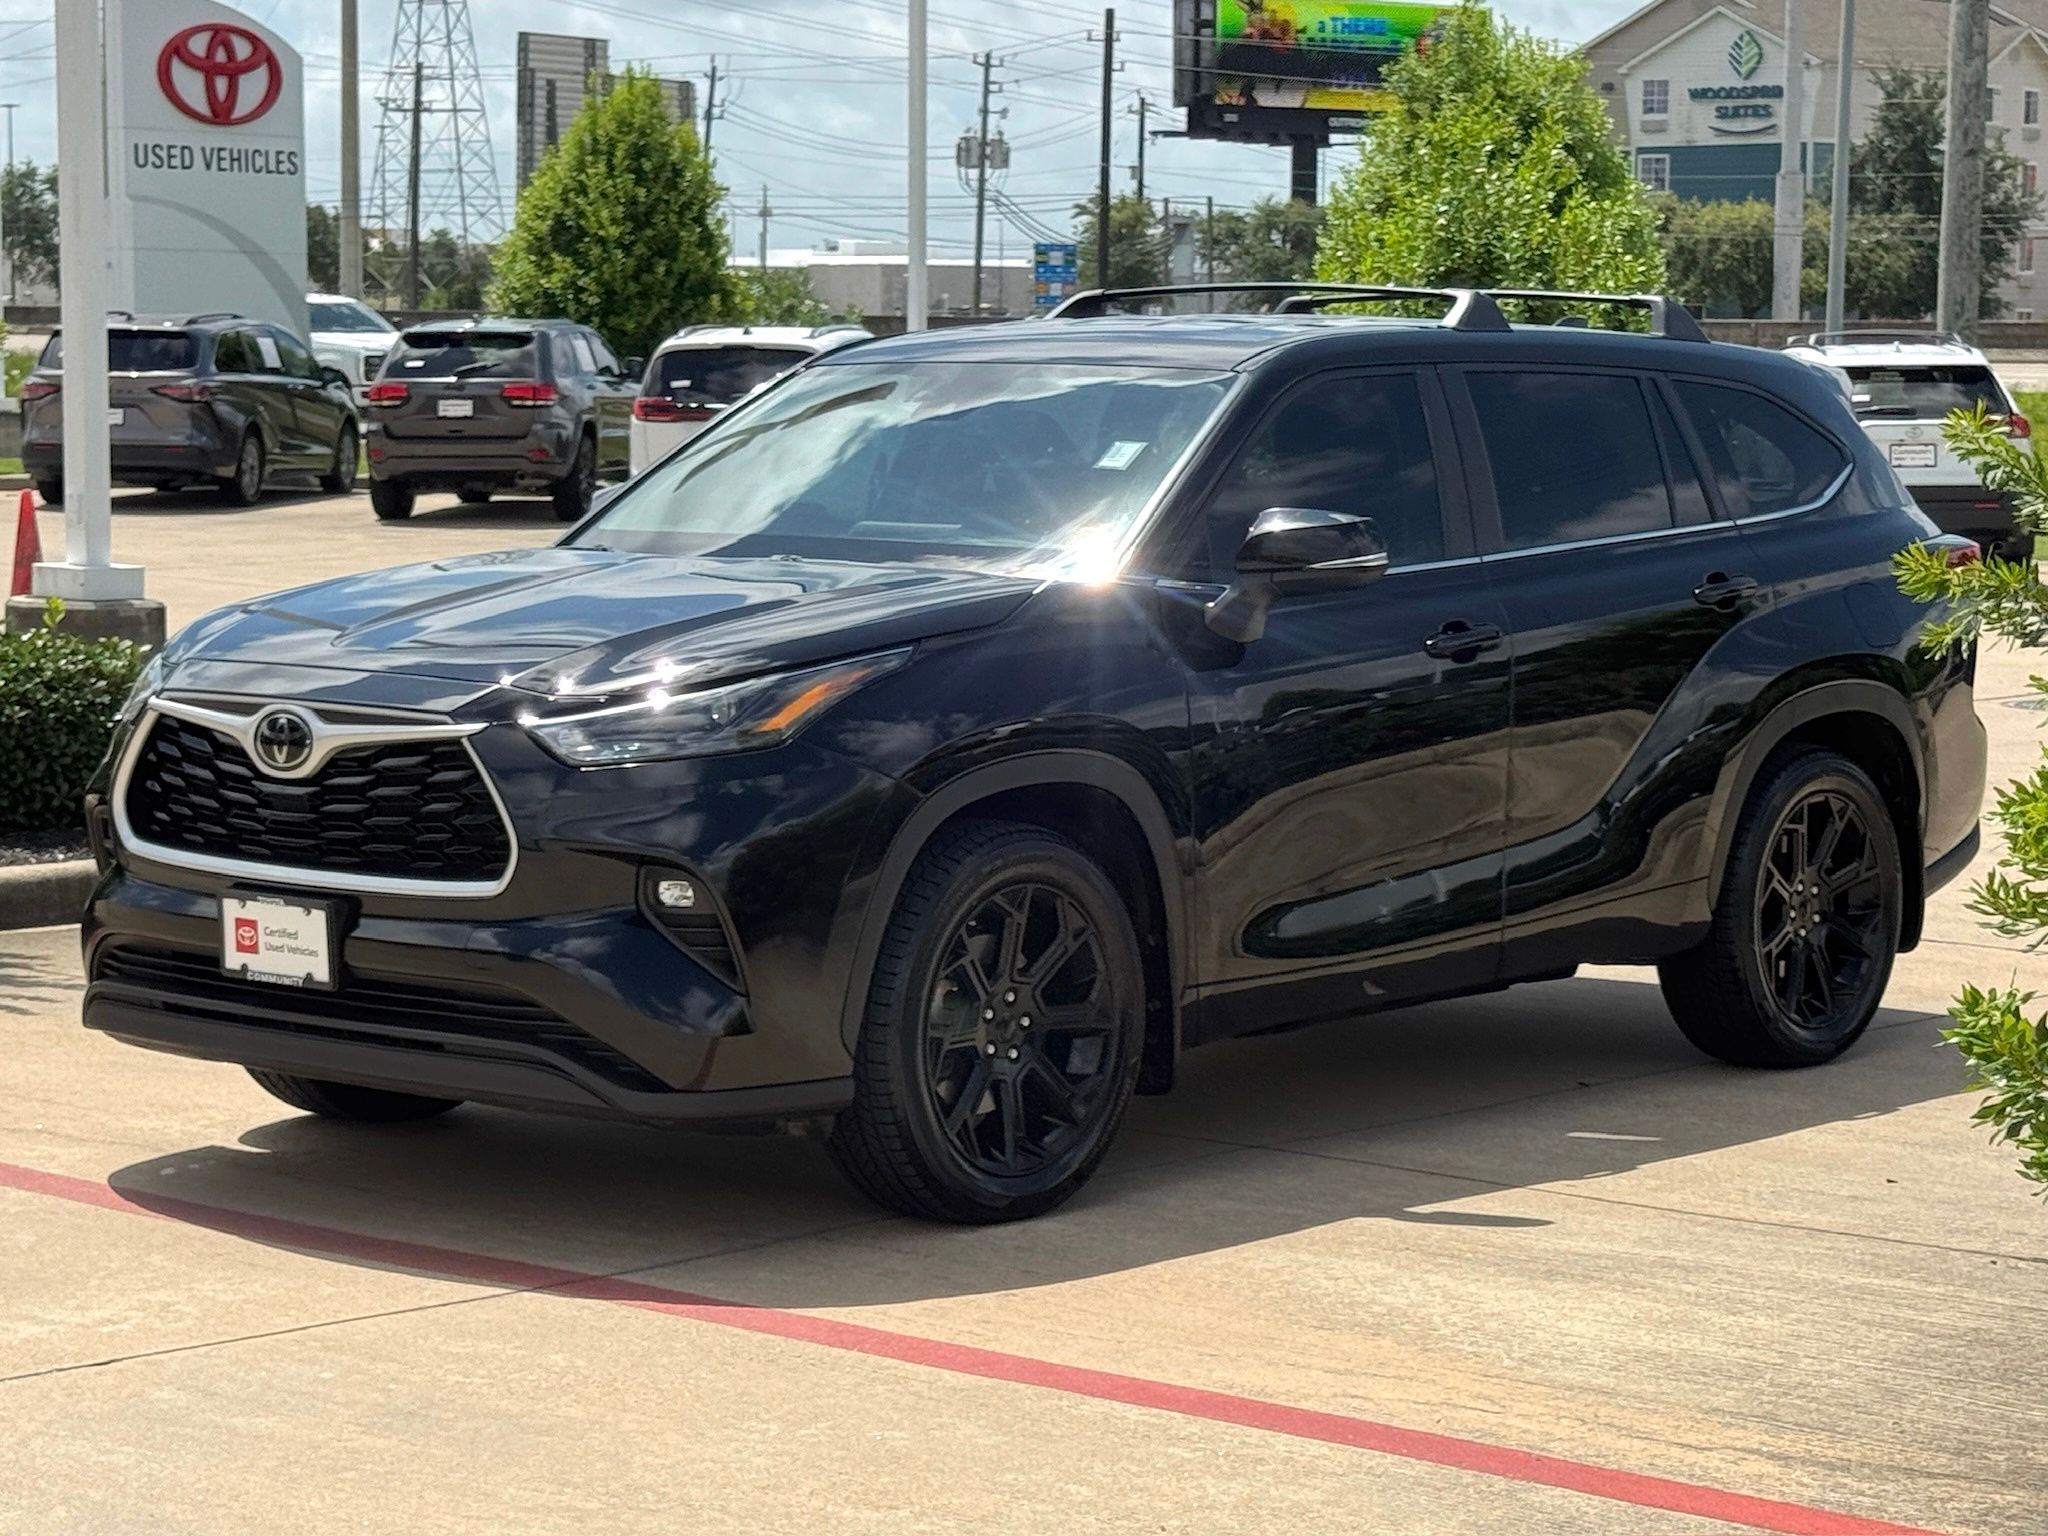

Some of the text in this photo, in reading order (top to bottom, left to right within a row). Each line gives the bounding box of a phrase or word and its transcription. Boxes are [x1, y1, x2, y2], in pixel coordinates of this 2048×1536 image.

[1687, 84, 1784, 100] WOODSPRIN
[1714, 103, 1774, 119] SUITES
[133, 142, 300, 175] USED VEHICLES
[263, 926, 299, 940] Certified
[264, 941, 319, 958] Used Vehicles
[246, 970, 304, 988] COMMUNITY
